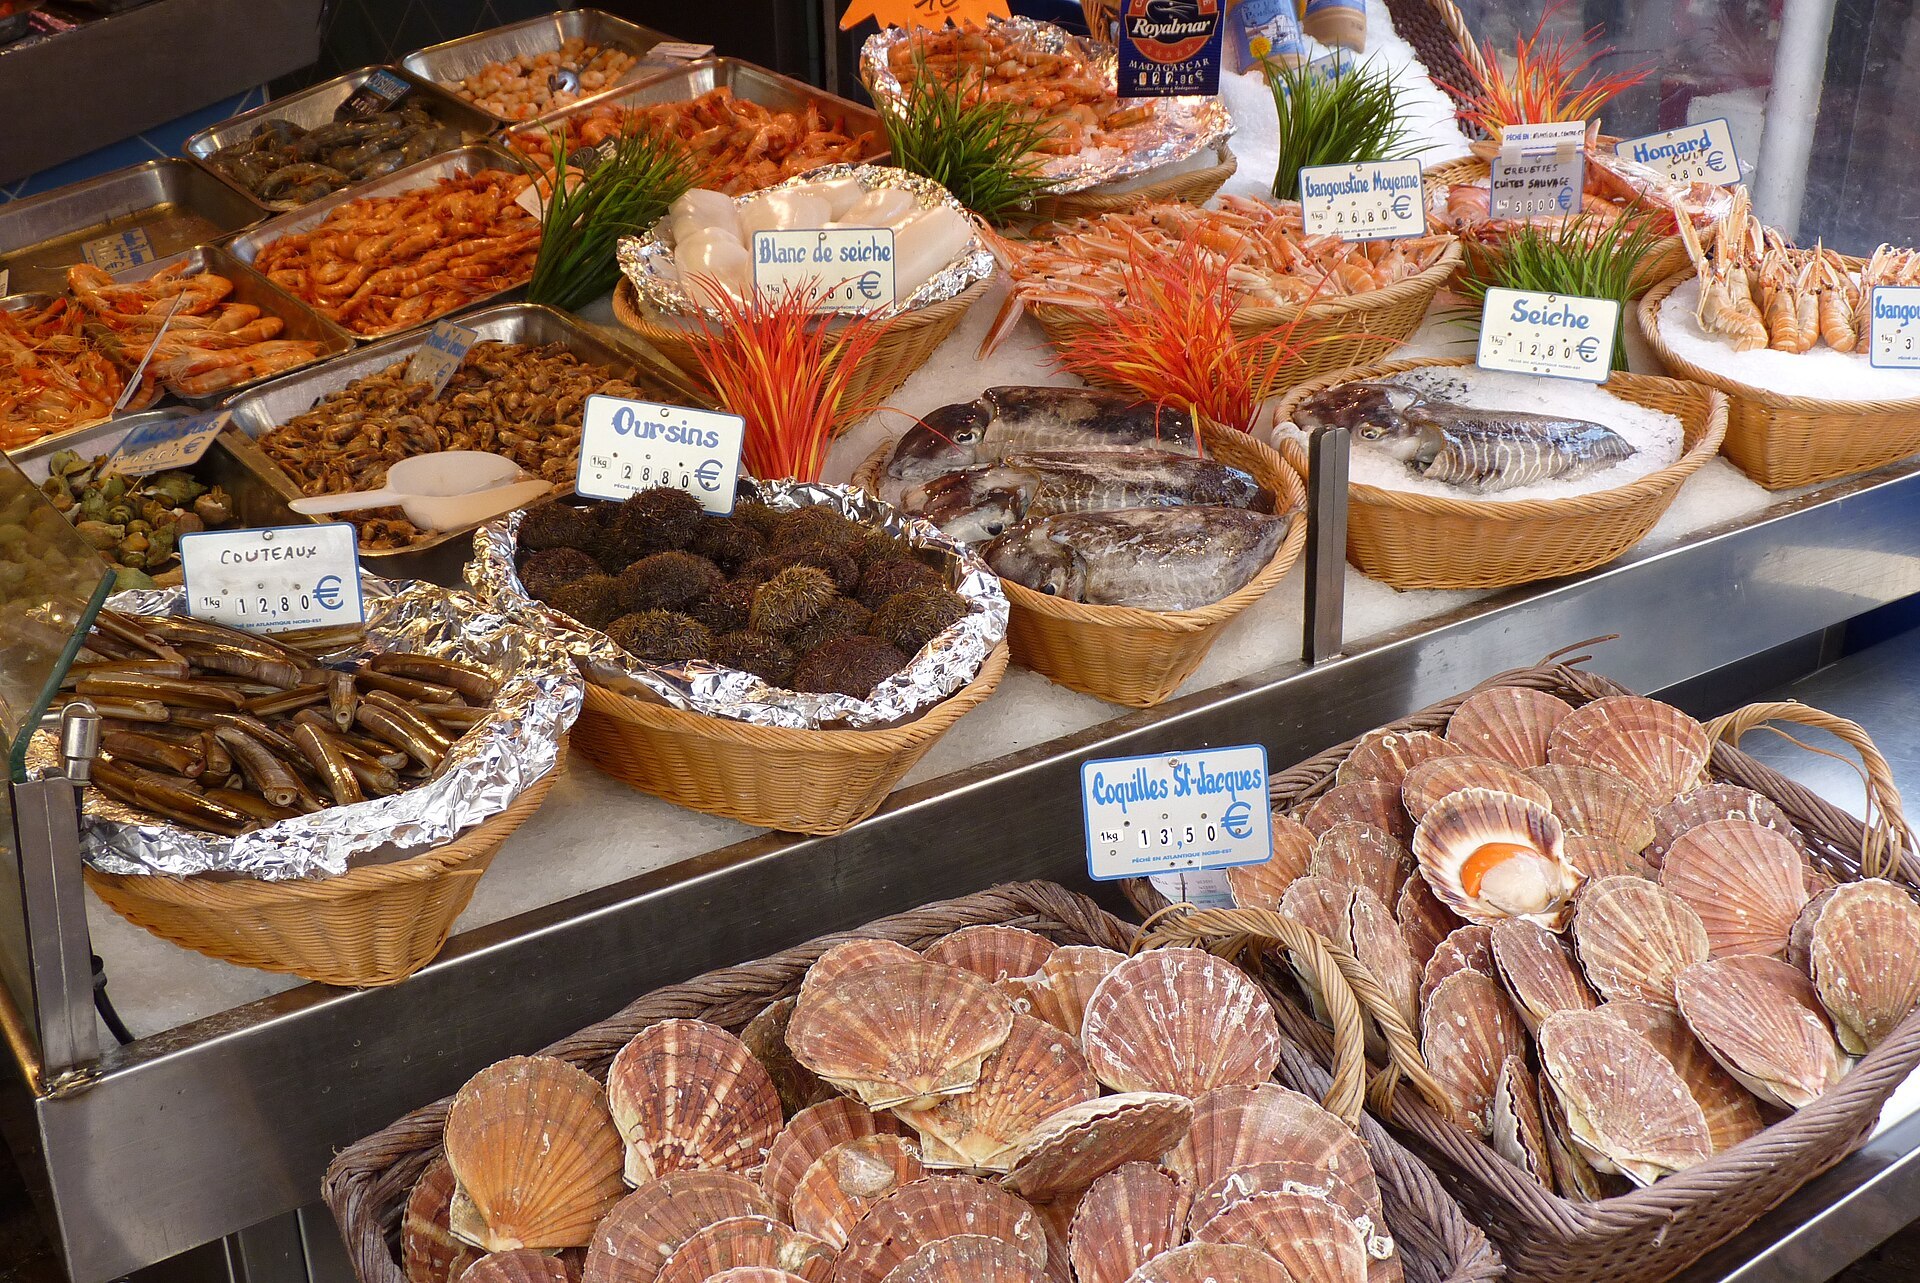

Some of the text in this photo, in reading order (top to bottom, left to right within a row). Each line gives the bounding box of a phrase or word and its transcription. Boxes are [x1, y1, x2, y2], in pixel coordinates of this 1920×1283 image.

[1132, 18, 1211, 38] Royalmar
[1633, 128, 1712, 163] Homard
[1672, 147, 1709, 165] CUIT
[1305, 169, 1418, 203] Langoustine Moyenne
[1528, 177, 1570, 188] SAUVAGE
[759, 235, 891, 263] Blanc de seiche
[1510, 299, 1590, 329] Seiche
[1491, 336, 1503, 346] 1kg
[1518, 341, 1571, 360] 12,80
[1881, 334, 1892, 343] 1kg
[611, 406, 719, 448] Oursins
[592, 456, 607, 468] 1kg
[220, 546, 317, 565] COUTEAUX
[204, 597, 220, 608] 1kg
[239, 595, 310, 618] 12,80
[1093, 761, 1262, 814] Coquilles St-Jacques
[1101, 830, 1119, 842] 1kg
[1163, 852, 1200, 860] ATLANTIQUE
